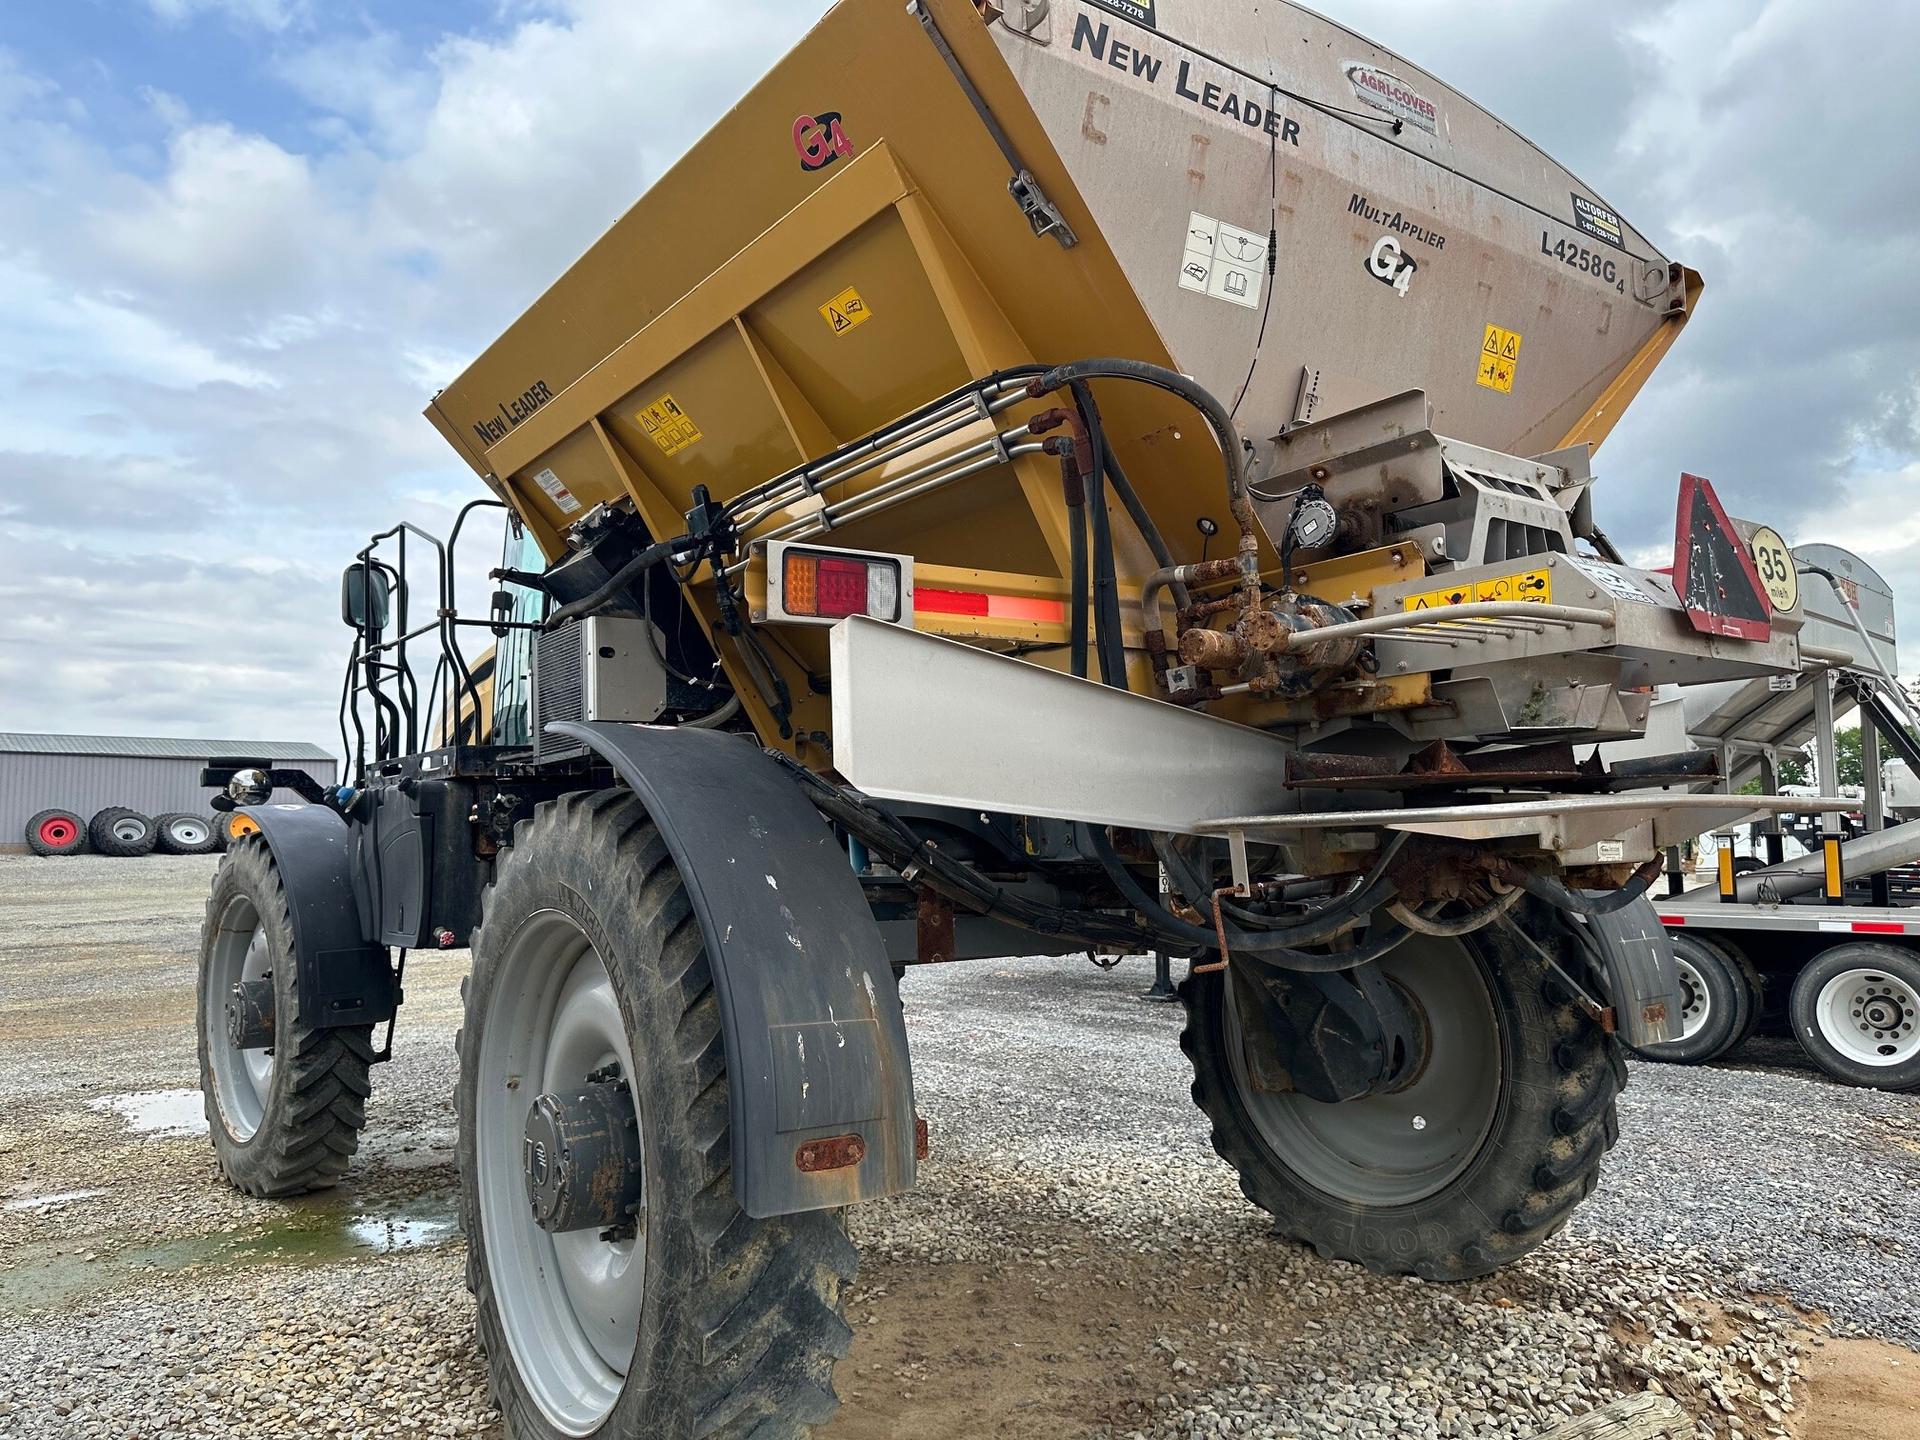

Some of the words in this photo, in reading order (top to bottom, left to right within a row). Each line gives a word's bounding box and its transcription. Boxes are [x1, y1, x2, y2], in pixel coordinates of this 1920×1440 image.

[1103, 0, 1145, 19] 28-7278
[1071, 13, 1162, 83] NEW
[1175, 60, 1301, 147] LEADER
[1360, 71, 1436, 118] AGRI-COVER
[1576, 198, 1619, 227] ALTORFER
[473, 416, 508, 447] NEW
[498, 380, 554, 426] LEADER
[1758, 546, 1787, 582] 35
